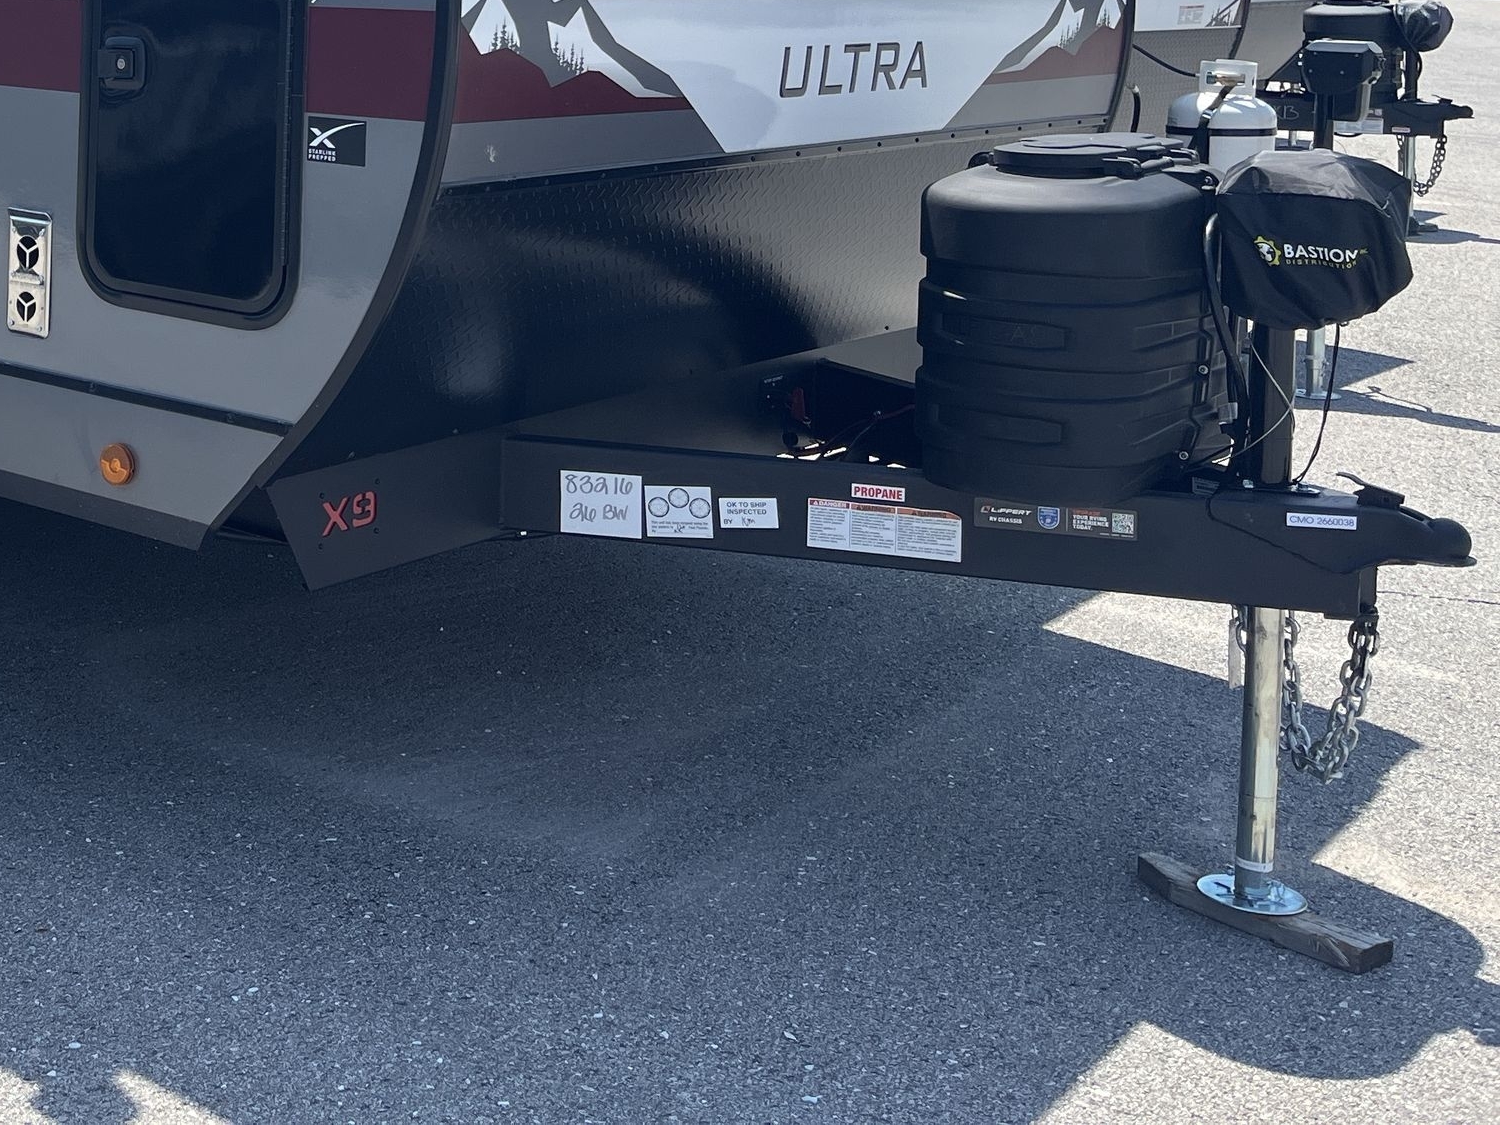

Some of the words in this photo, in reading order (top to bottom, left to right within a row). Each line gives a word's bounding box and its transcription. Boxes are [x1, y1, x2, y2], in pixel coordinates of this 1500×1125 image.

[779, 40, 928, 98] ULTRA
[308, 148, 336, 156] STARLINK
[308, 154, 336, 162] PREPPED
[1283, 243, 1359, 263] BASTION
[1286, 259, 1357, 269] DISTRIBUTION
[854, 486, 903, 500] PROPANE
[819, 500, 847, 508] DANGER
[322, 491, 376, 536] X9
[603, 504, 628, 521] BW
[1289, 515, 1314, 524] CMO
[1316, 517, 1355, 527] 2660038
